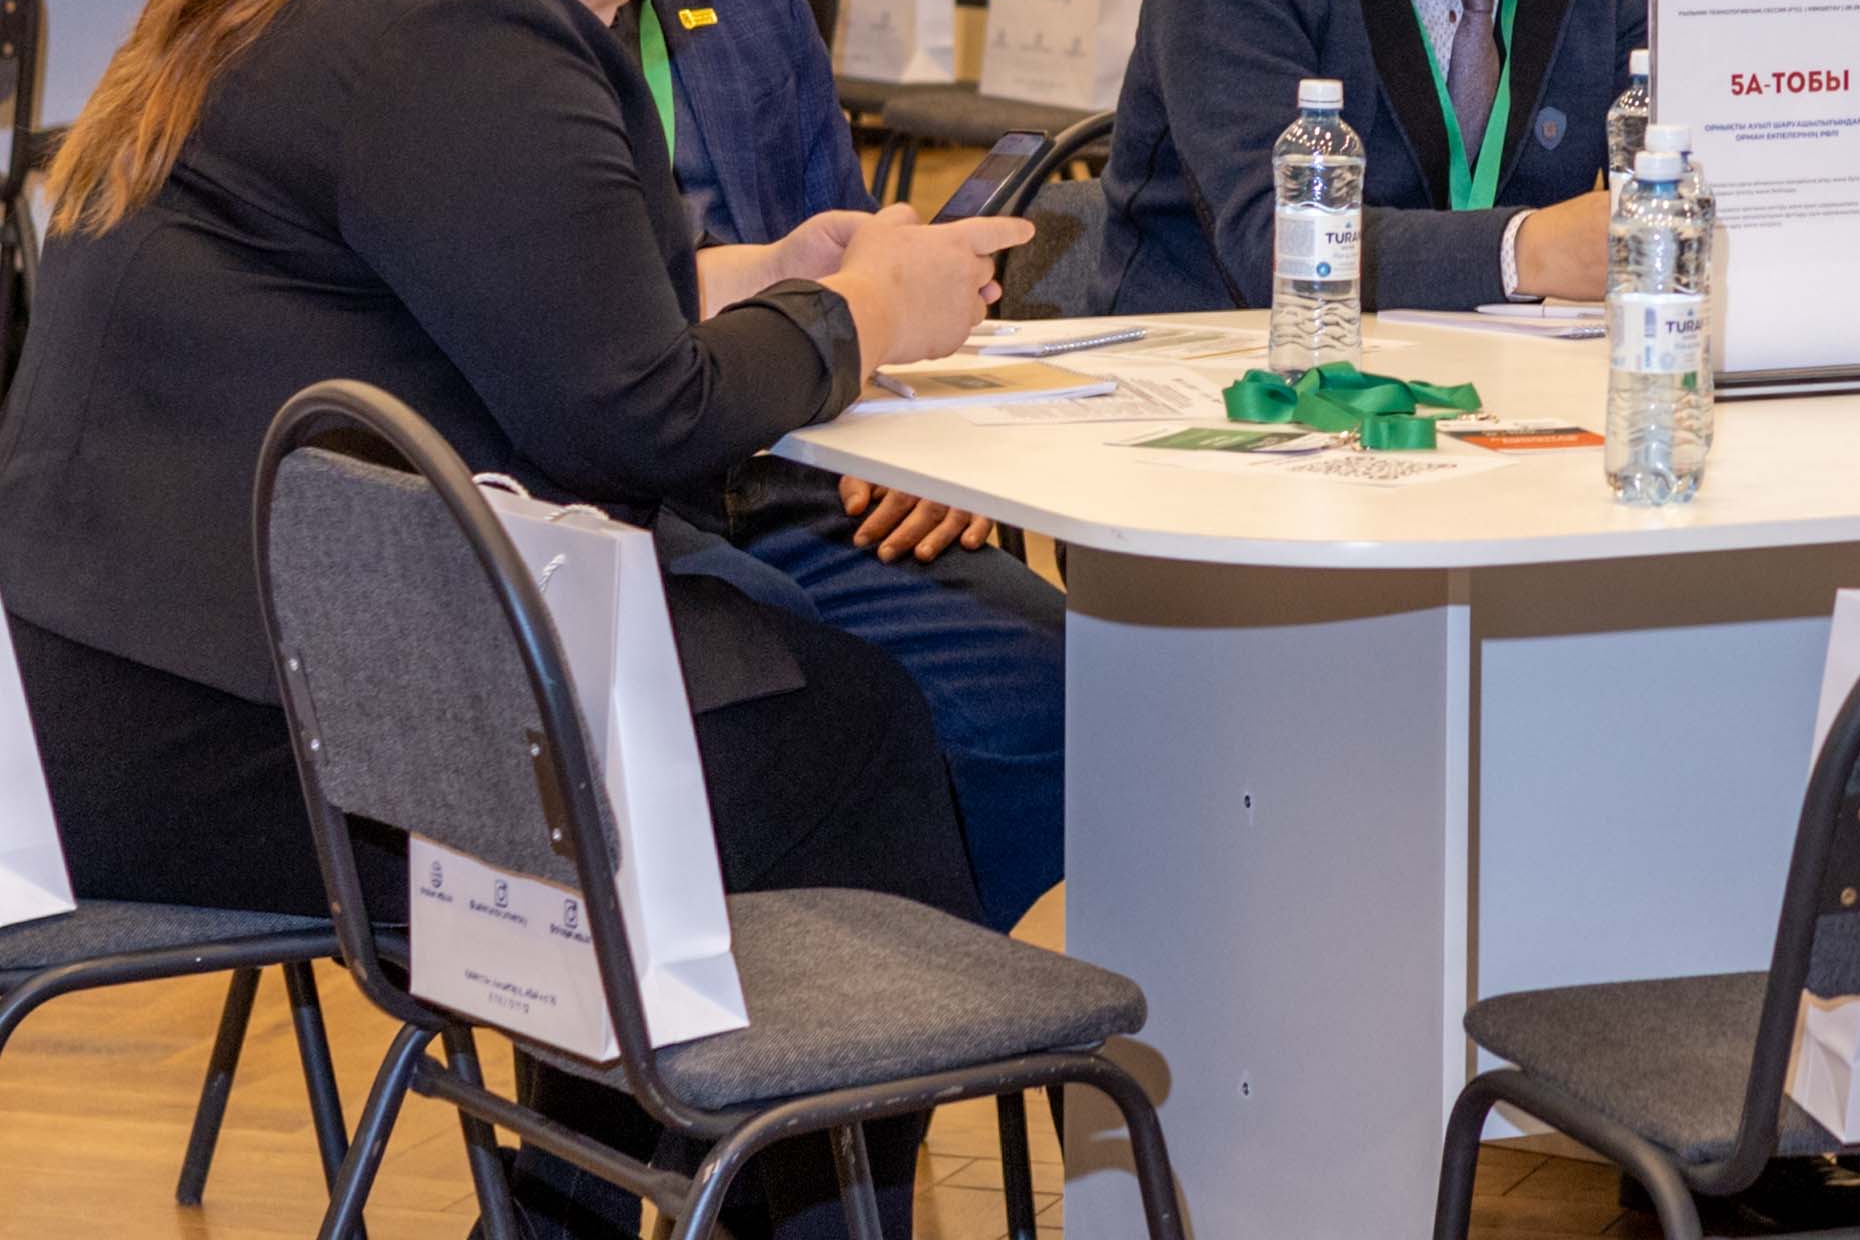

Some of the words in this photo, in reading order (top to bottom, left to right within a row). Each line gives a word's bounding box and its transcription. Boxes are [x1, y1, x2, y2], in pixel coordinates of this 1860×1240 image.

[1730, 69, 1850, 97] 5А-ТОБЫ
[1325, 231, 1360, 244] TURA
[1665, 320, 1702, 333] TURA
